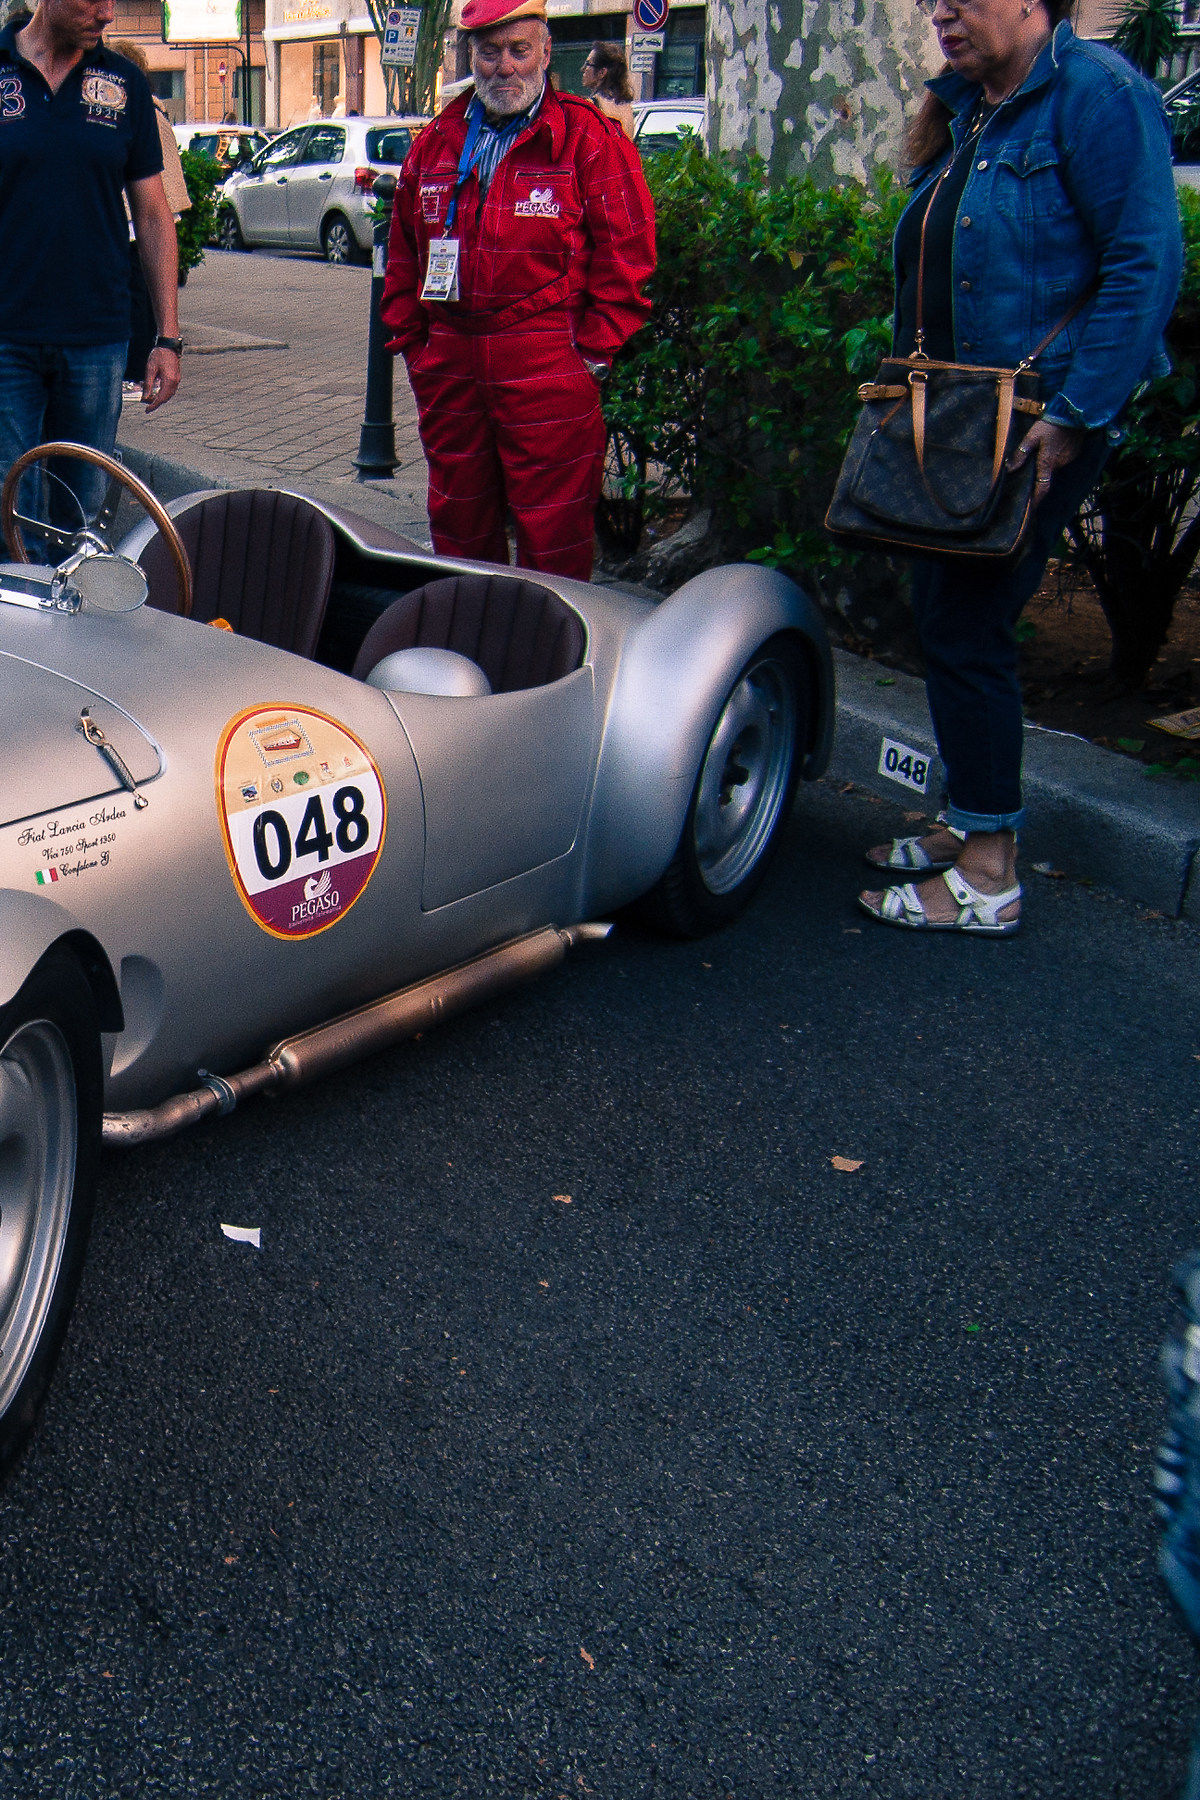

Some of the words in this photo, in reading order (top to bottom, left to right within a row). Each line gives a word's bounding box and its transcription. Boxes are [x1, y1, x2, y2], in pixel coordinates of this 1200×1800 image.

[515, 201, 560, 214] PEGASO
[885, 747, 927, 785] 048
[17, 827, 46, 846] Fiat
[47, 820, 87, 838] Lancia
[89, 806, 127, 826] Ardea
[253, 785, 370, 881] 048
[60, 844, 74, 857] 750
[292, 890, 340, 922] PEGASO
